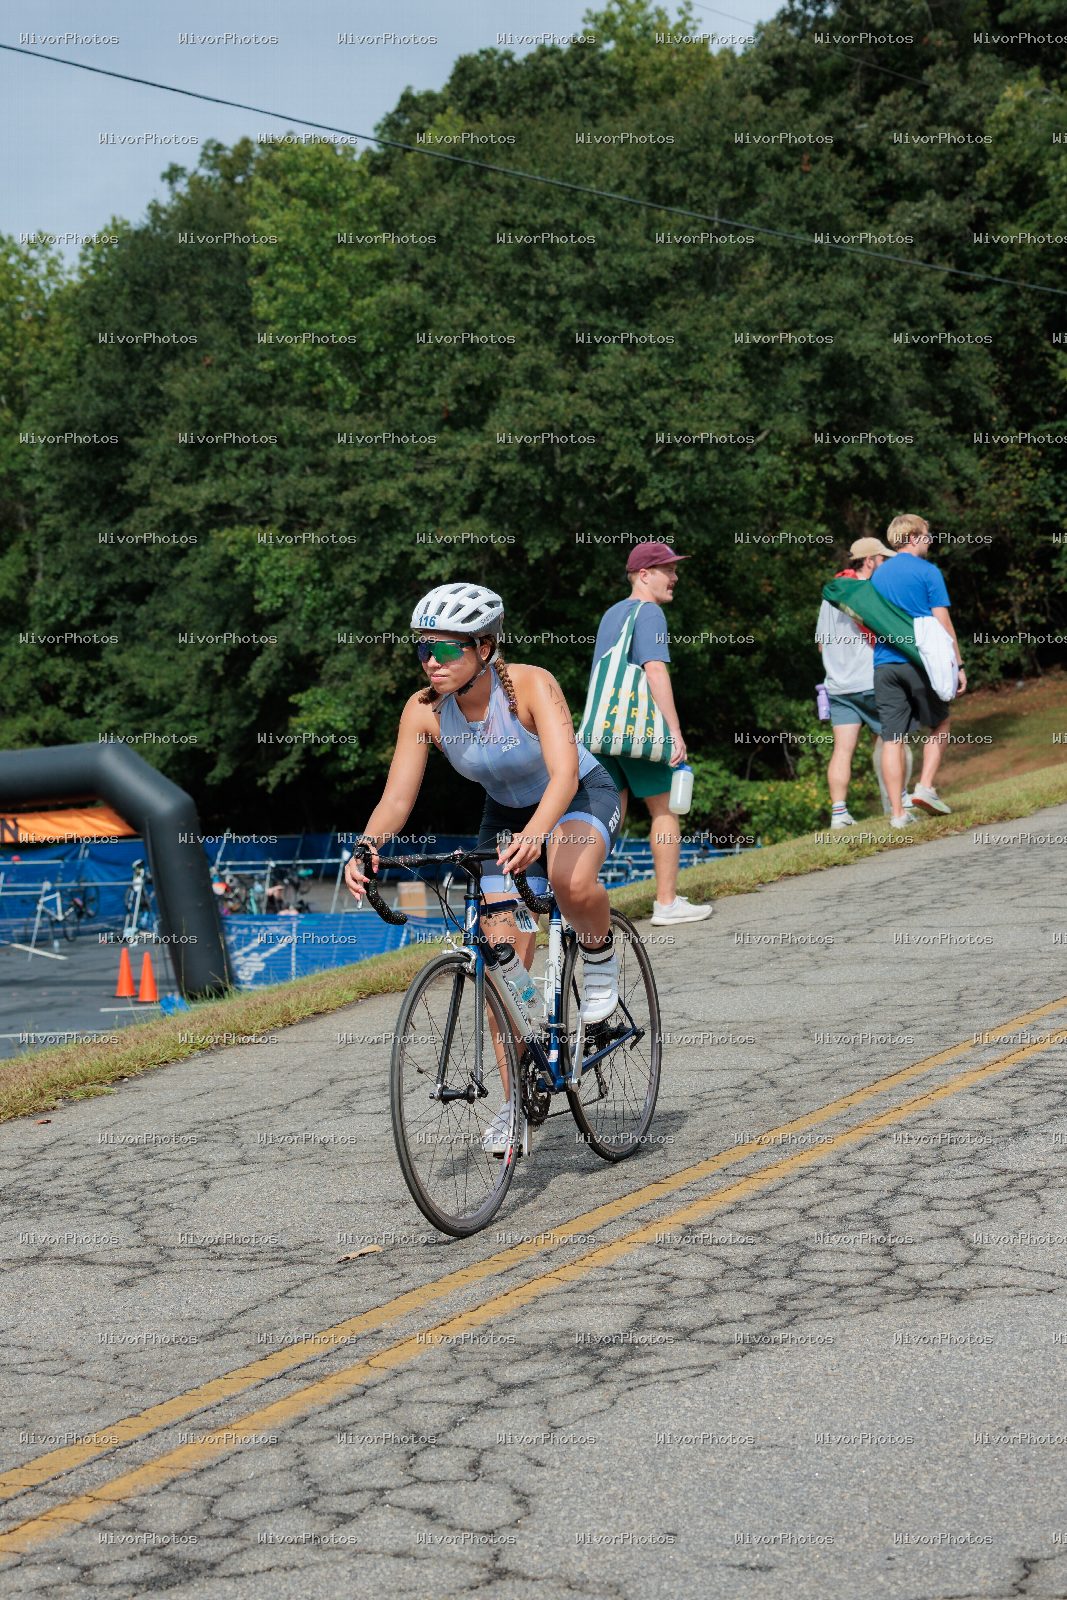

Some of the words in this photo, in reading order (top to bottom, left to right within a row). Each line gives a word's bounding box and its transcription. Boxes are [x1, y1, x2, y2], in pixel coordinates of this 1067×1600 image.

[418, 615, 437, 628] 116
[602, 720, 654, 738] PARIS
[515, 908, 533, 931] 116
